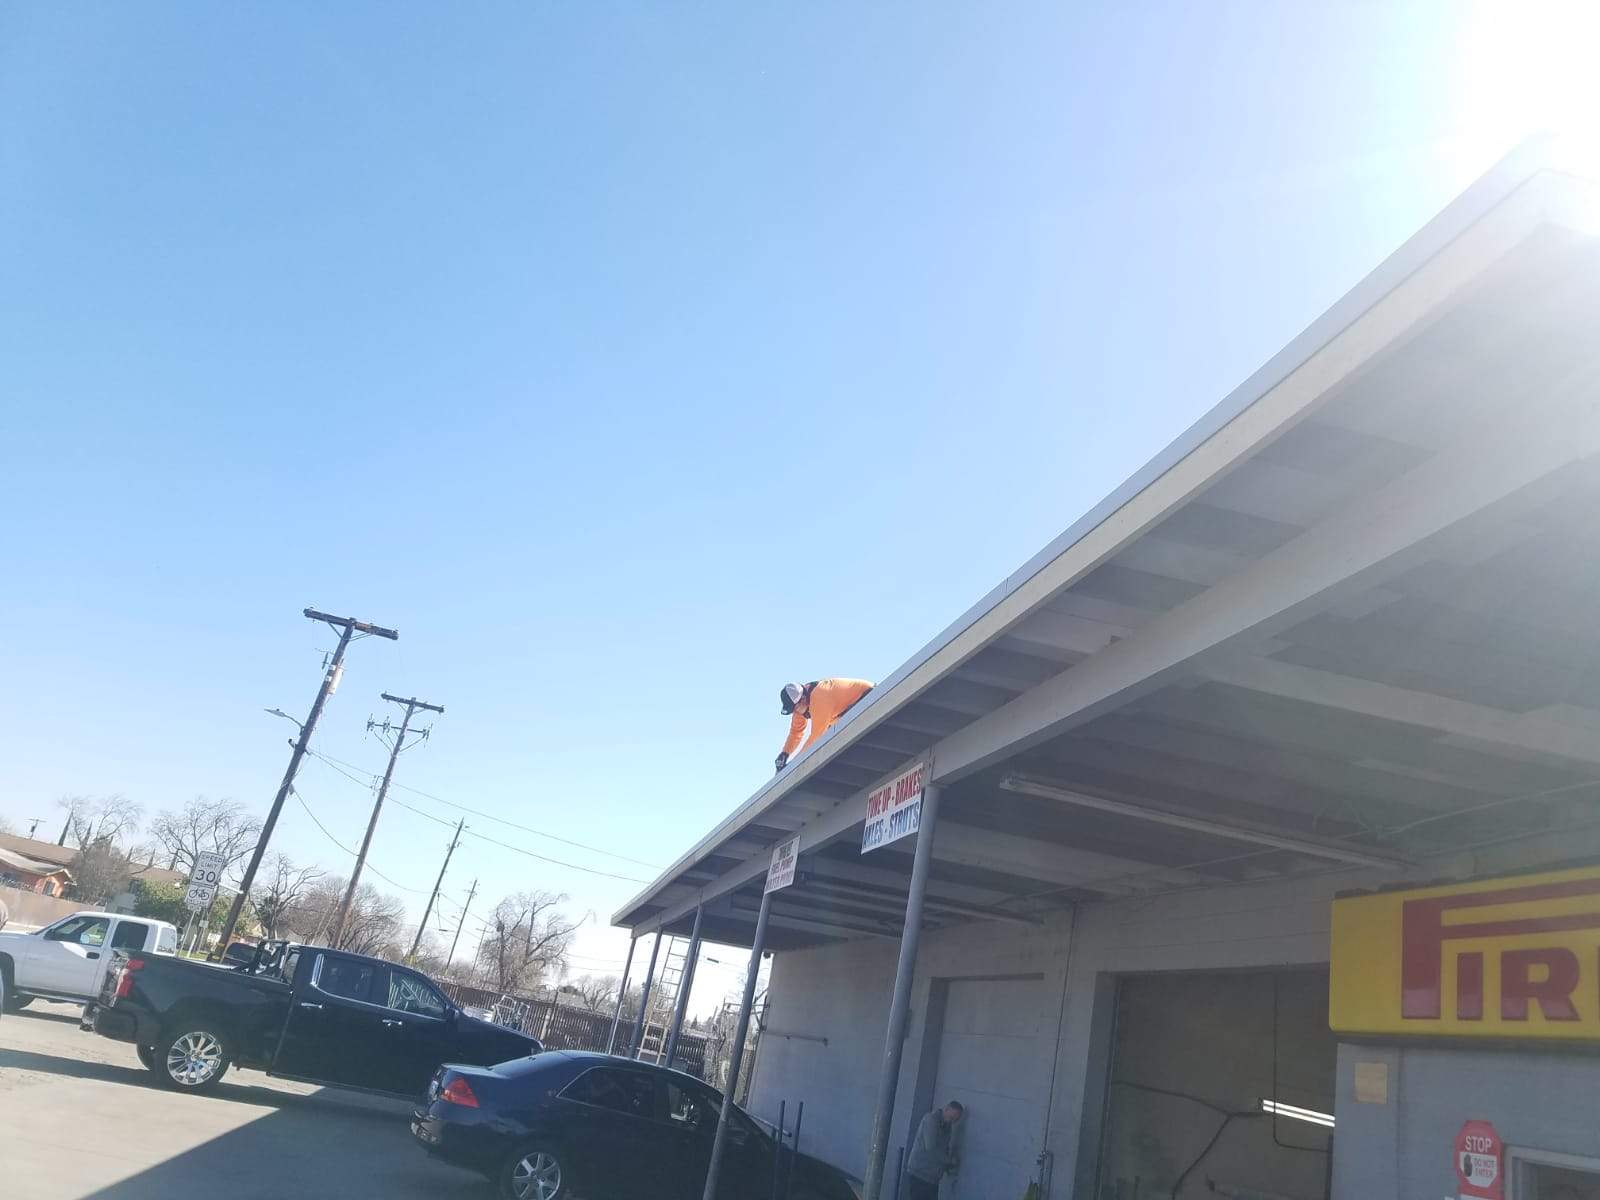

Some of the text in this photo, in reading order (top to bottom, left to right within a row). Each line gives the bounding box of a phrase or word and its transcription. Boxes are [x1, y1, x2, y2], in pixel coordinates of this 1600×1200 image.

[867, 791, 883, 819] TUNE
[882, 787, 891, 813] UP
[895, 768, 922, 806] BRAKES
[888, 802, 920, 841] STRUTS
[202, 855, 223, 863] SPEED
[195, 869, 216, 883] 30
[1402, 878, 1600, 1021] PIR
[1464, 1135, 1492, 1153] STOP
